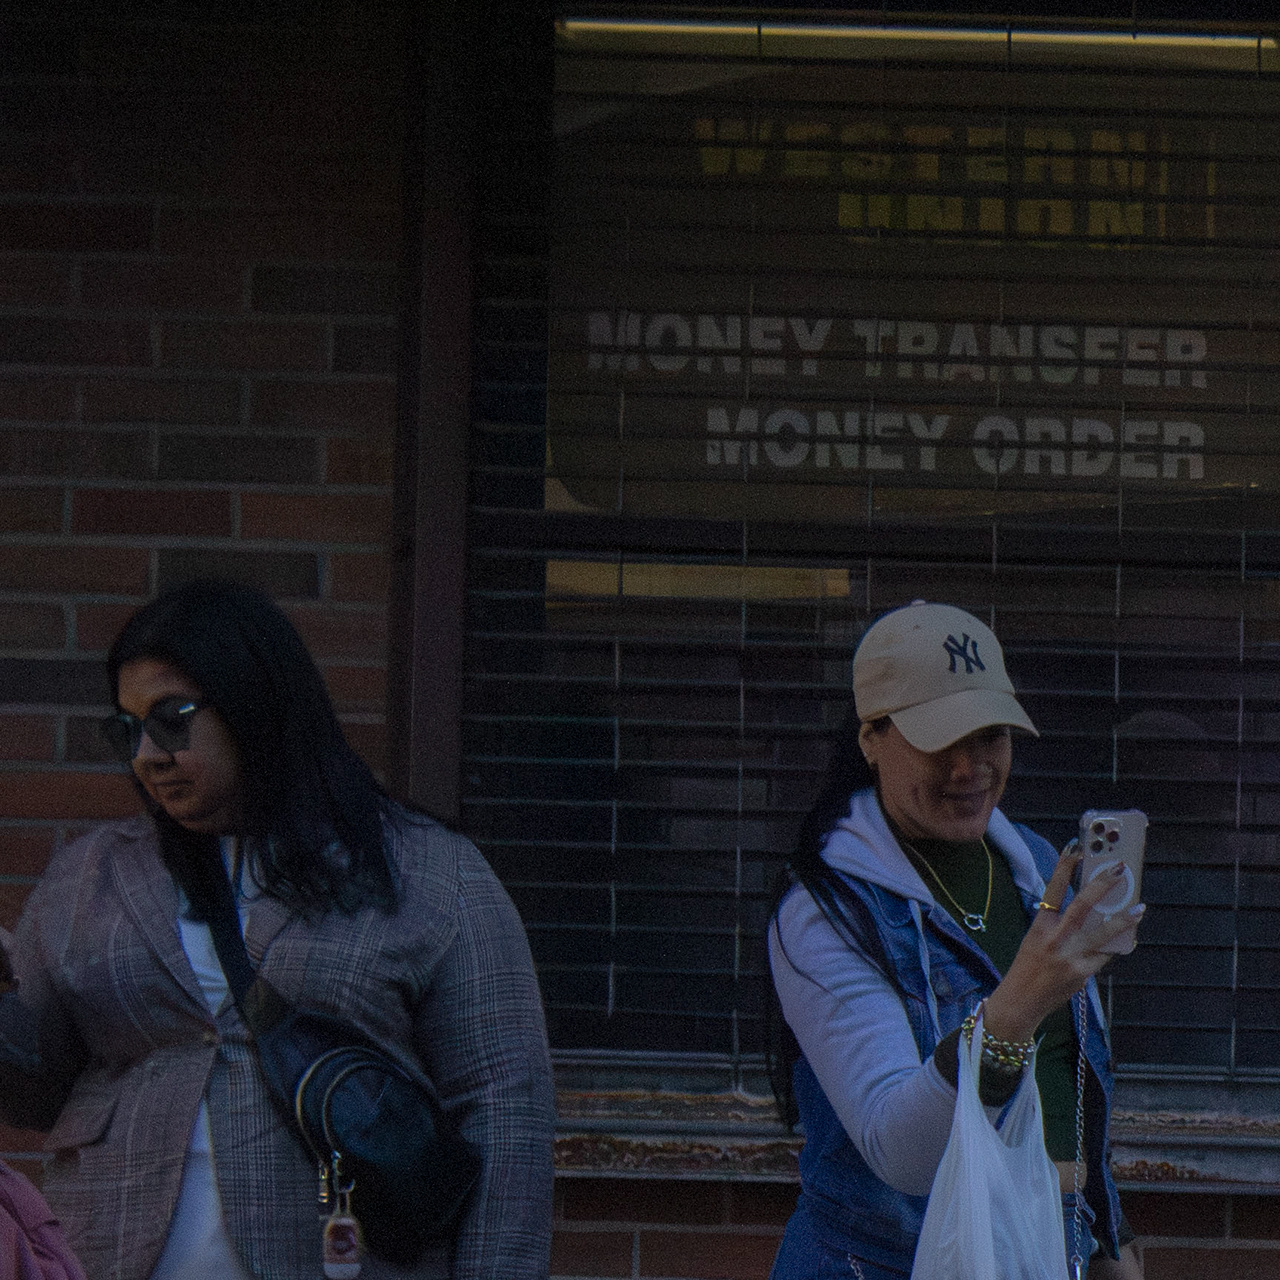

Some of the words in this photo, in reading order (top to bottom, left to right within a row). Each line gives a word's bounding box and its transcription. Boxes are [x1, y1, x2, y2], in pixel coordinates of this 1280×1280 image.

[586, 312, 832, 376] MONEY
[853, 318, 1208, 389] TRANSFER
[705, 407, 951, 470] MONEY
[972, 415, 1205, 480] ORDER
